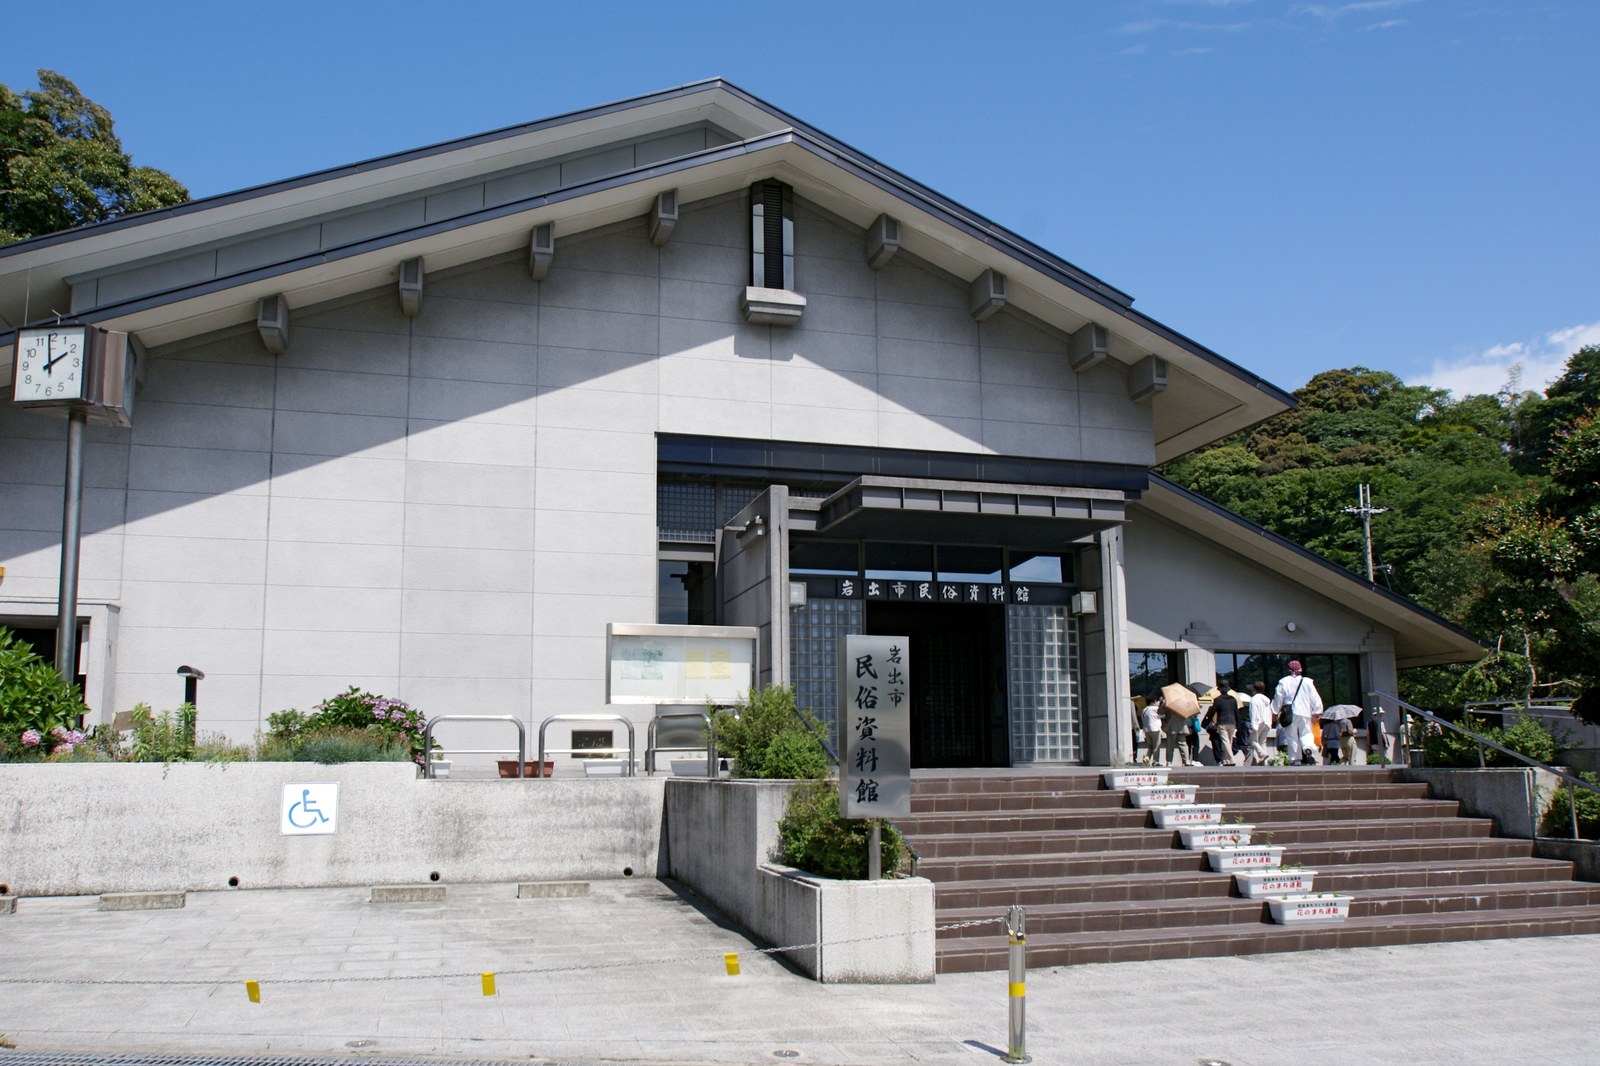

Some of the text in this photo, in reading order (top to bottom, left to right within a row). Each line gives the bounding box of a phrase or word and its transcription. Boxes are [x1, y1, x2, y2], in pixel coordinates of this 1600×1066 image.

[36, 338, 44, 346] 11
[63, 336, 67, 345] 1
[27, 348, 37, 358] 10
[70, 344, 77, 353] 2
[22, 361, 29, 371] 9
[73, 358, 80, 367] 3
[25, 375, 32, 384] 8
[68, 373, 74, 381] 4
[35, 384, 41, 393] 7
[45, 387, 52, 396] 6
[58, 382, 65, 392] 5
[841, 580, 1030, 602] 岩出市民俗資料館
[886, 645, 905, 708] 岩出市
[855, 654, 879, 803] 民俗資料館
